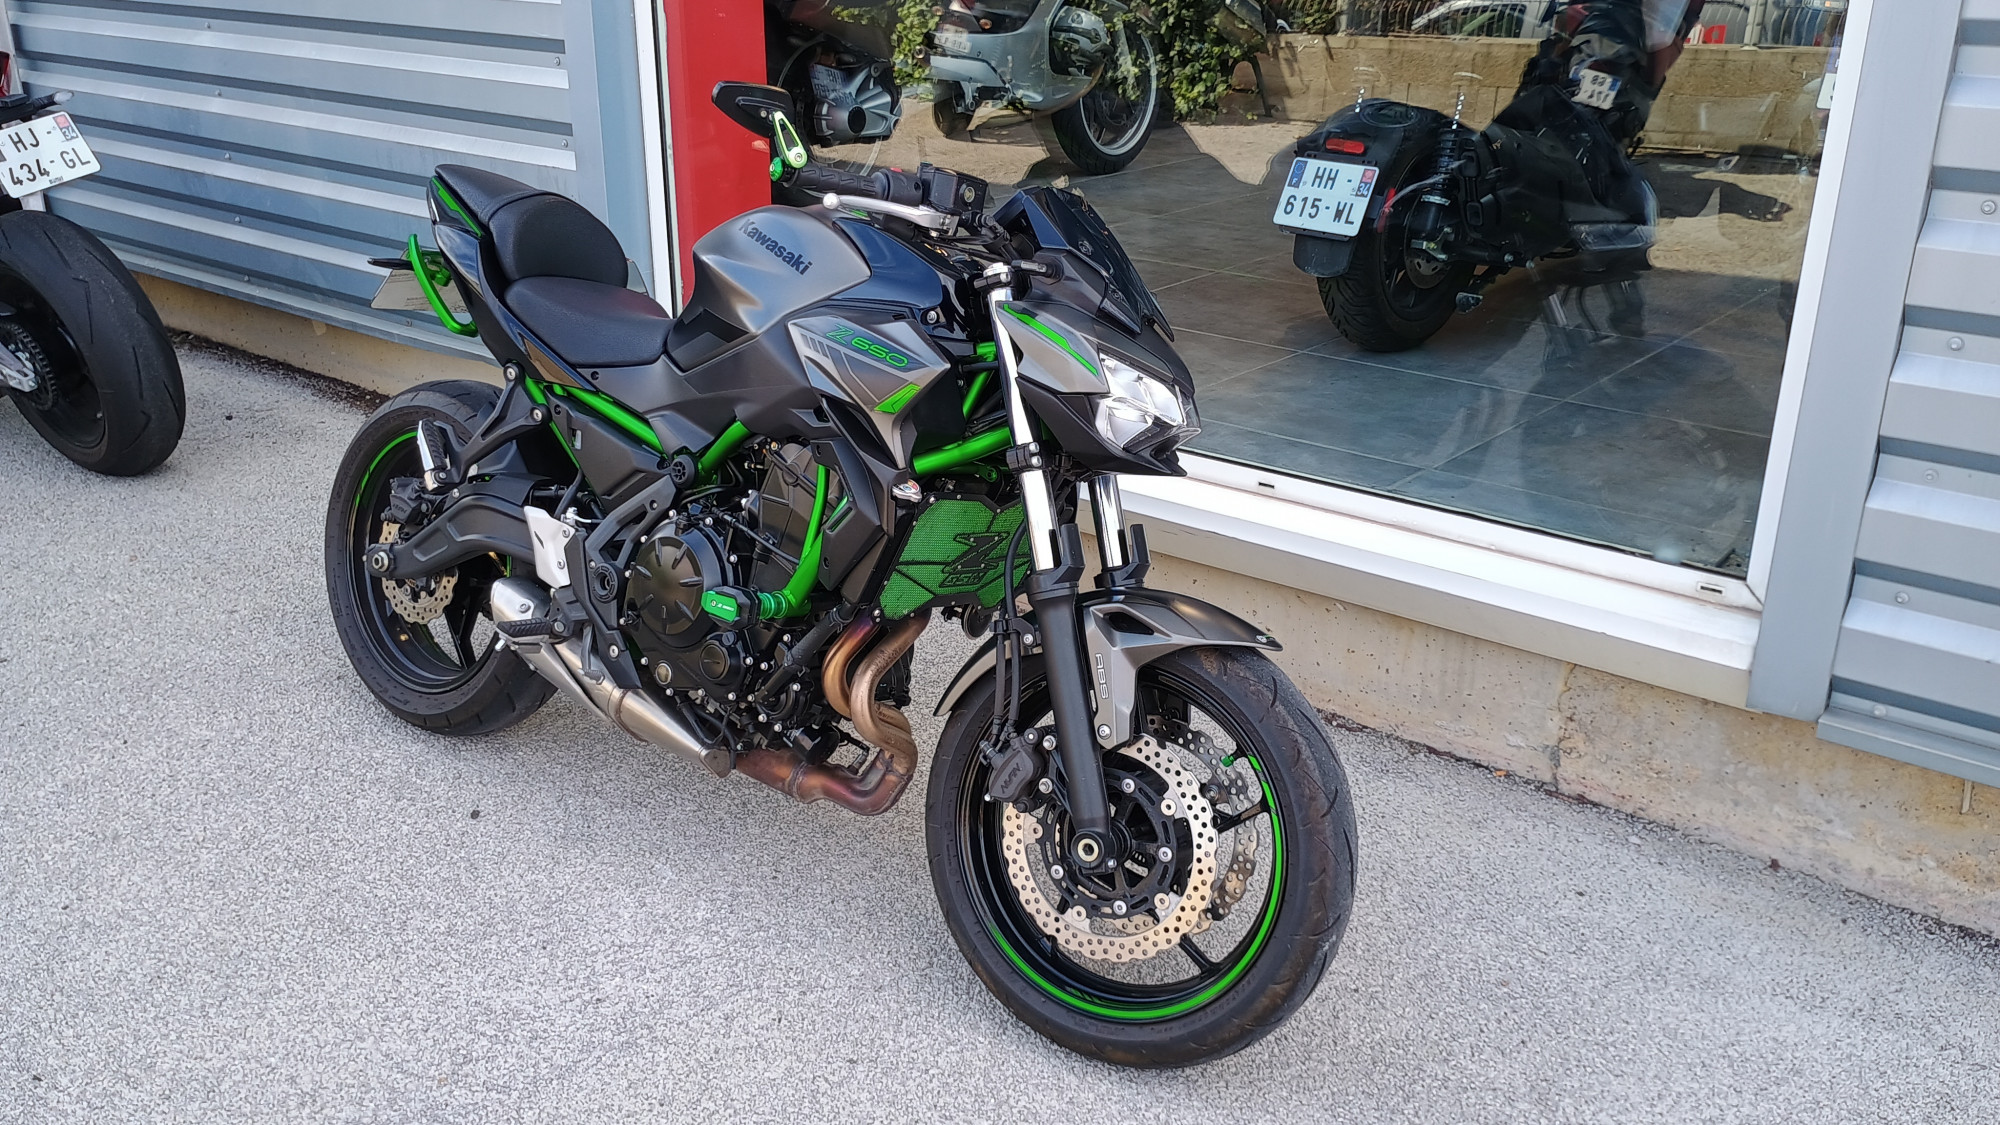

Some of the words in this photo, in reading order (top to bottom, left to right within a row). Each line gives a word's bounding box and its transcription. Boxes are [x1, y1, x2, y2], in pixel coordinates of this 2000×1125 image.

[8, 128, 40, 153] HJ
[62, 127, 77, 140] 34
[1311, 166, 1340, 191] HH
[1356, 183, 1371, 196] 34
[738, 218, 813, 276] Kawasaki
[851, 336, 908, 368] 650
[1095, 653, 1109, 699] ABS
